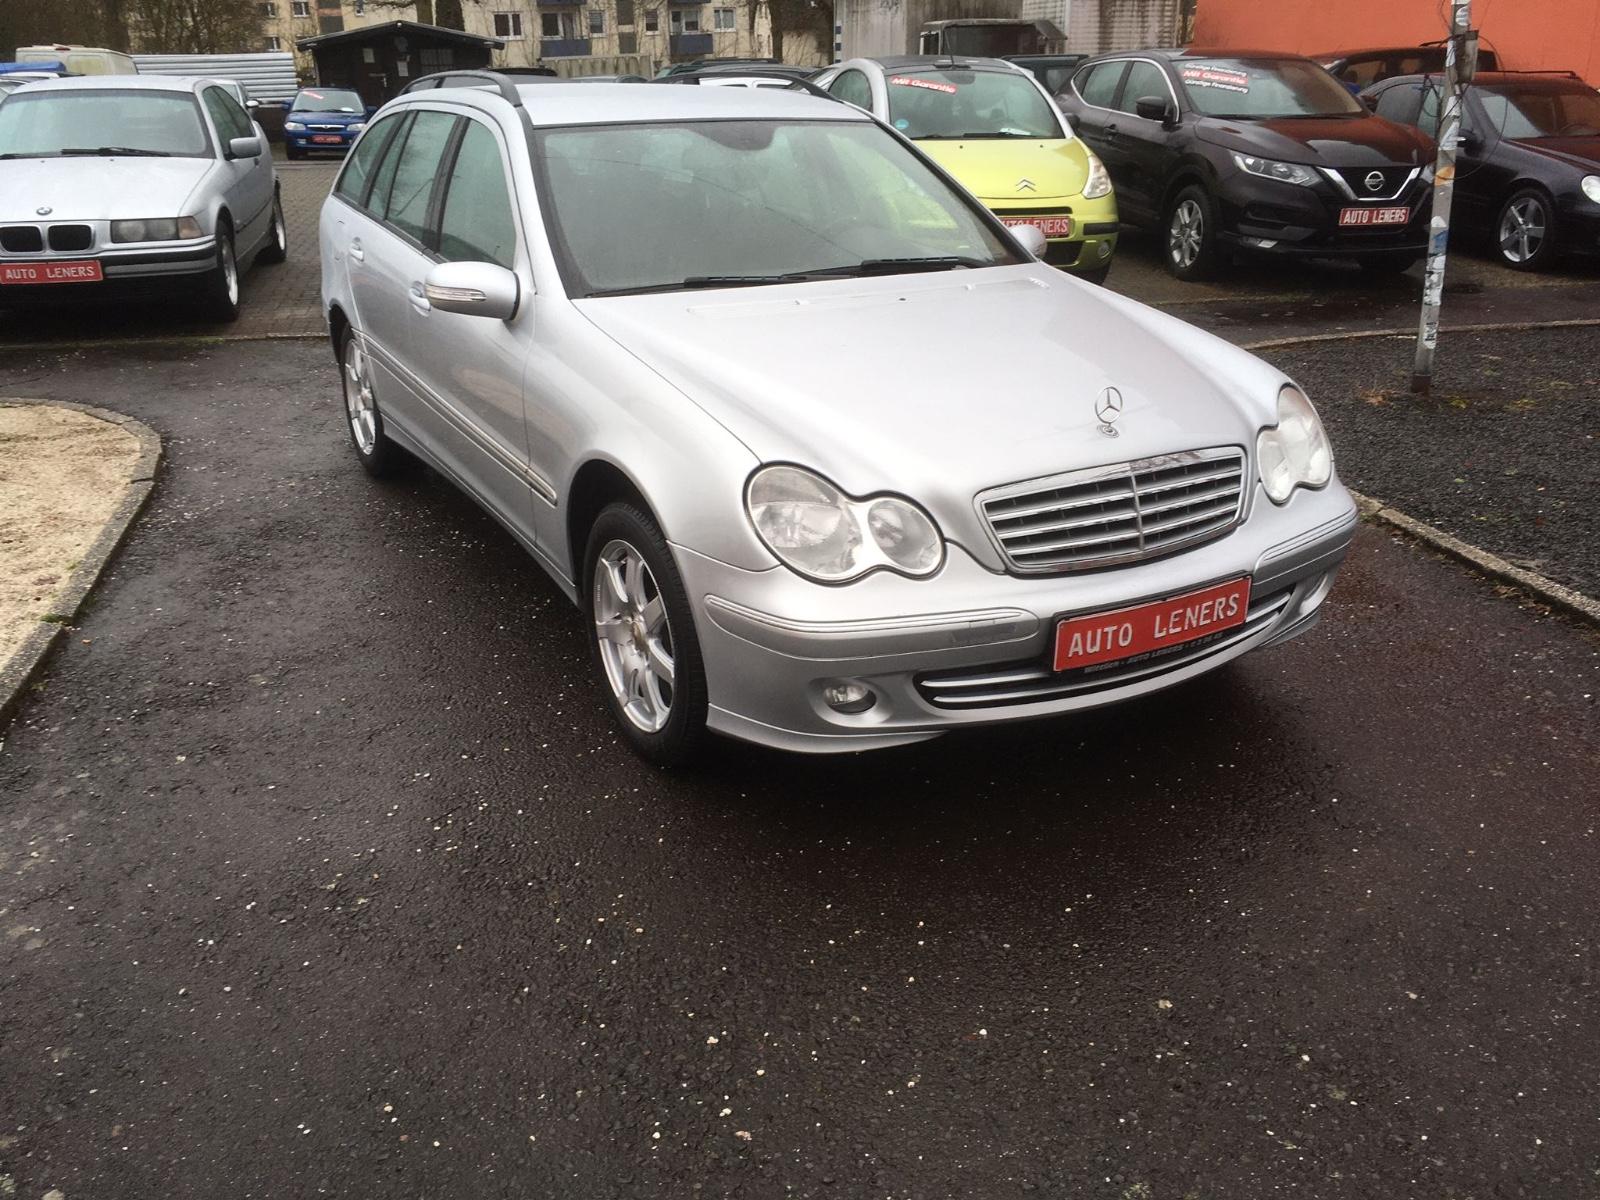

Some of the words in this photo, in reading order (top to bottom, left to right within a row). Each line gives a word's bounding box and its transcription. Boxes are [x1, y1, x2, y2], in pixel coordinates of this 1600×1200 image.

[891, 76, 910, 85] Mit
[911, 79, 957, 94] Garantie
[1183, 70, 1201, 78] Mit
[1202, 72, 1246, 85] Garantie
[1344, 210, 1369, 224] AUTO
[1372, 209, 1407, 223] LENERS
[5, 267, 37, 280] AUTO
[46, 265, 96, 279] LENERS
[1067, 622, 1133, 658] AUTO
[1153, 592, 1241, 639] LENERS
